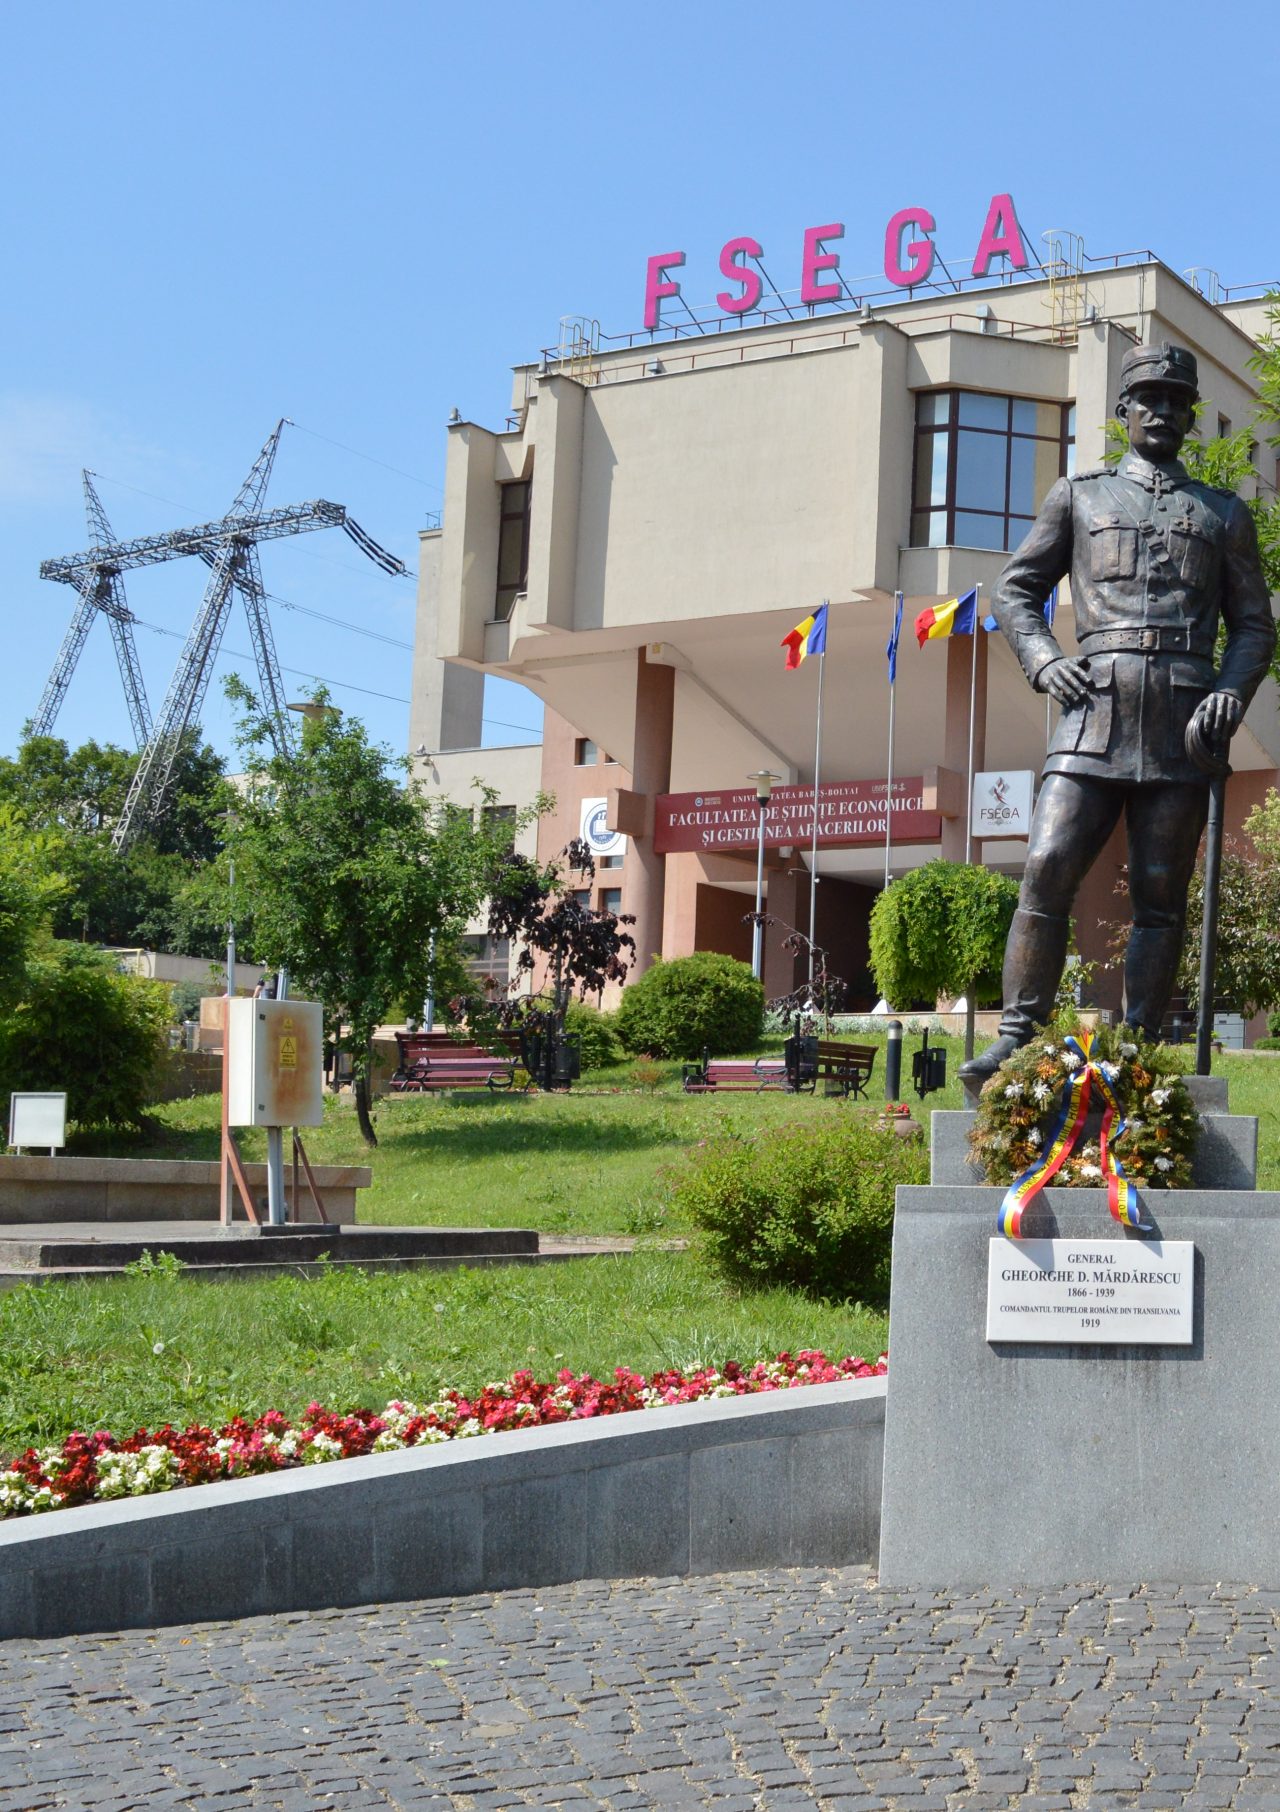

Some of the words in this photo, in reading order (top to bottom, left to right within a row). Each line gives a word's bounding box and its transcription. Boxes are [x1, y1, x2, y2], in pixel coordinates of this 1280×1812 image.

[643, 193, 1029, 329] FSEGA
[733, 792, 796, 803] UNIVETATEA
[799, 787, 858, 798] BABȘ-BOLYAI
[669, 809, 756, 826] FACULTATEA
[760, 807, 779, 820] DE
[980, 808, 1019, 819] FSEGA
[702, 830, 713, 846] ȘI
[796, 819, 887, 837] AFACERILOR
[1067, 1254, 1116, 1264] GENERAL
[1001, 1269, 1074, 1282] GHEORGHE
[1078, 1271, 1089, 1282] D.
[1093, 1269, 1181, 1284] MĂRDĂRESCU
[1068, 1287, 1087, 1297] 1866
[1096, 1288, 1115, 1297] 1939
[999, 1304, 1052, 1313] COMANDANTUL
[1053, 1306, 1088, 1314] TRUPELOR
[1089, 1305, 1119, 1315] ROMÂNE
[1120, 1307, 1132, 1315] DIN
[1133, 1307, 1181, 1315] TRANSILVANIA
[1081, 1318, 1100, 1328] 1919
